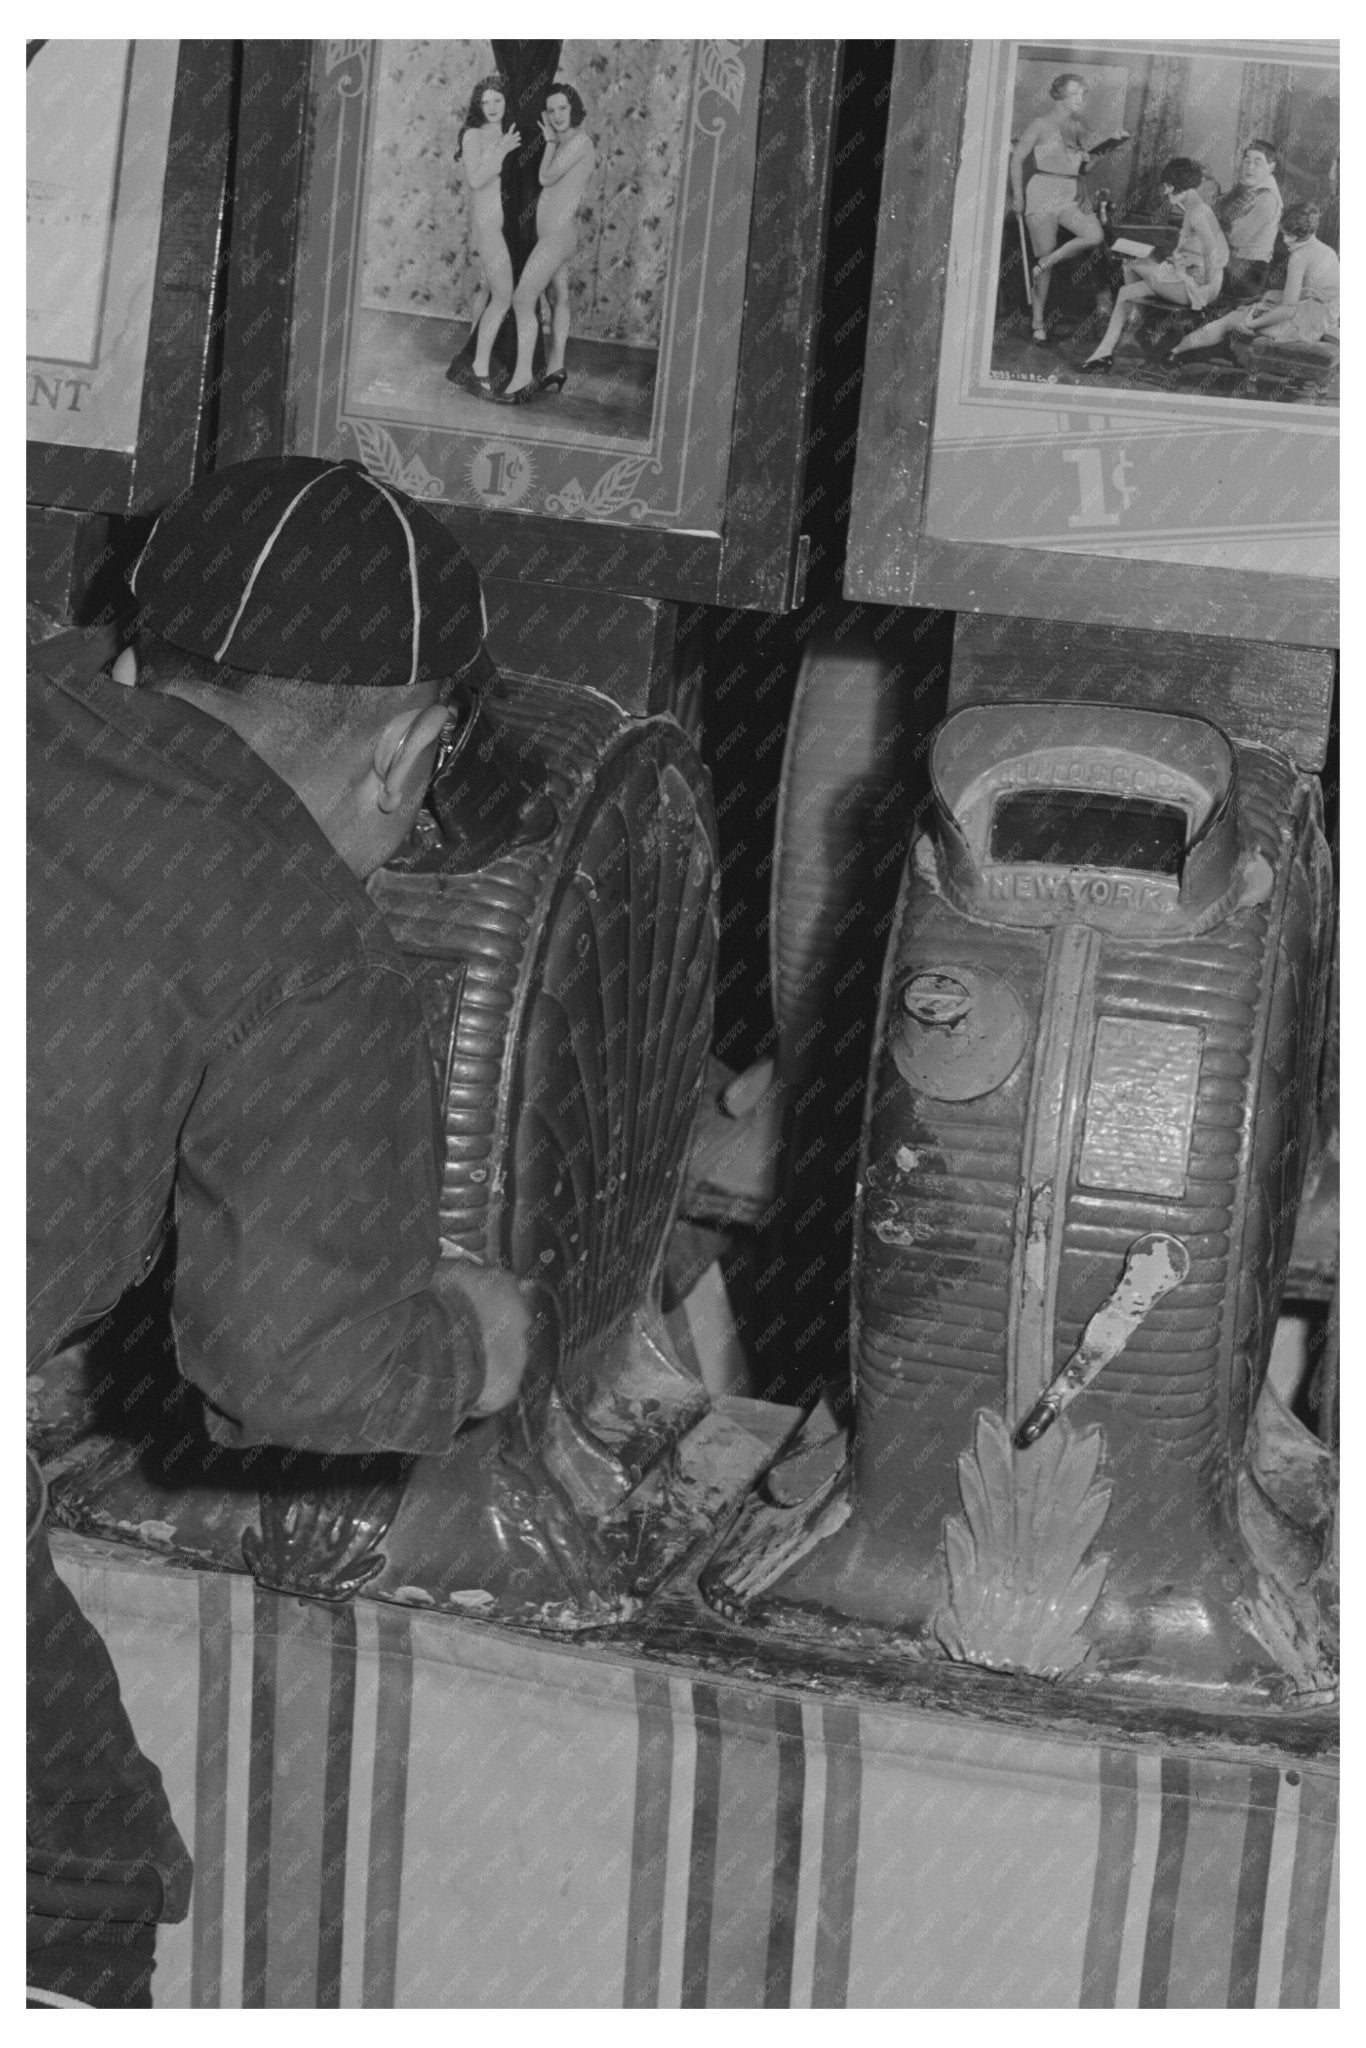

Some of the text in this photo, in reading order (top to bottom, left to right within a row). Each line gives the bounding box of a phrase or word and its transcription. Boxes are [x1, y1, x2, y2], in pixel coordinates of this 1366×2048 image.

[1062, 447, 1134, 528] 1¢
[990, 872, 1165, 912] NEW YORK
